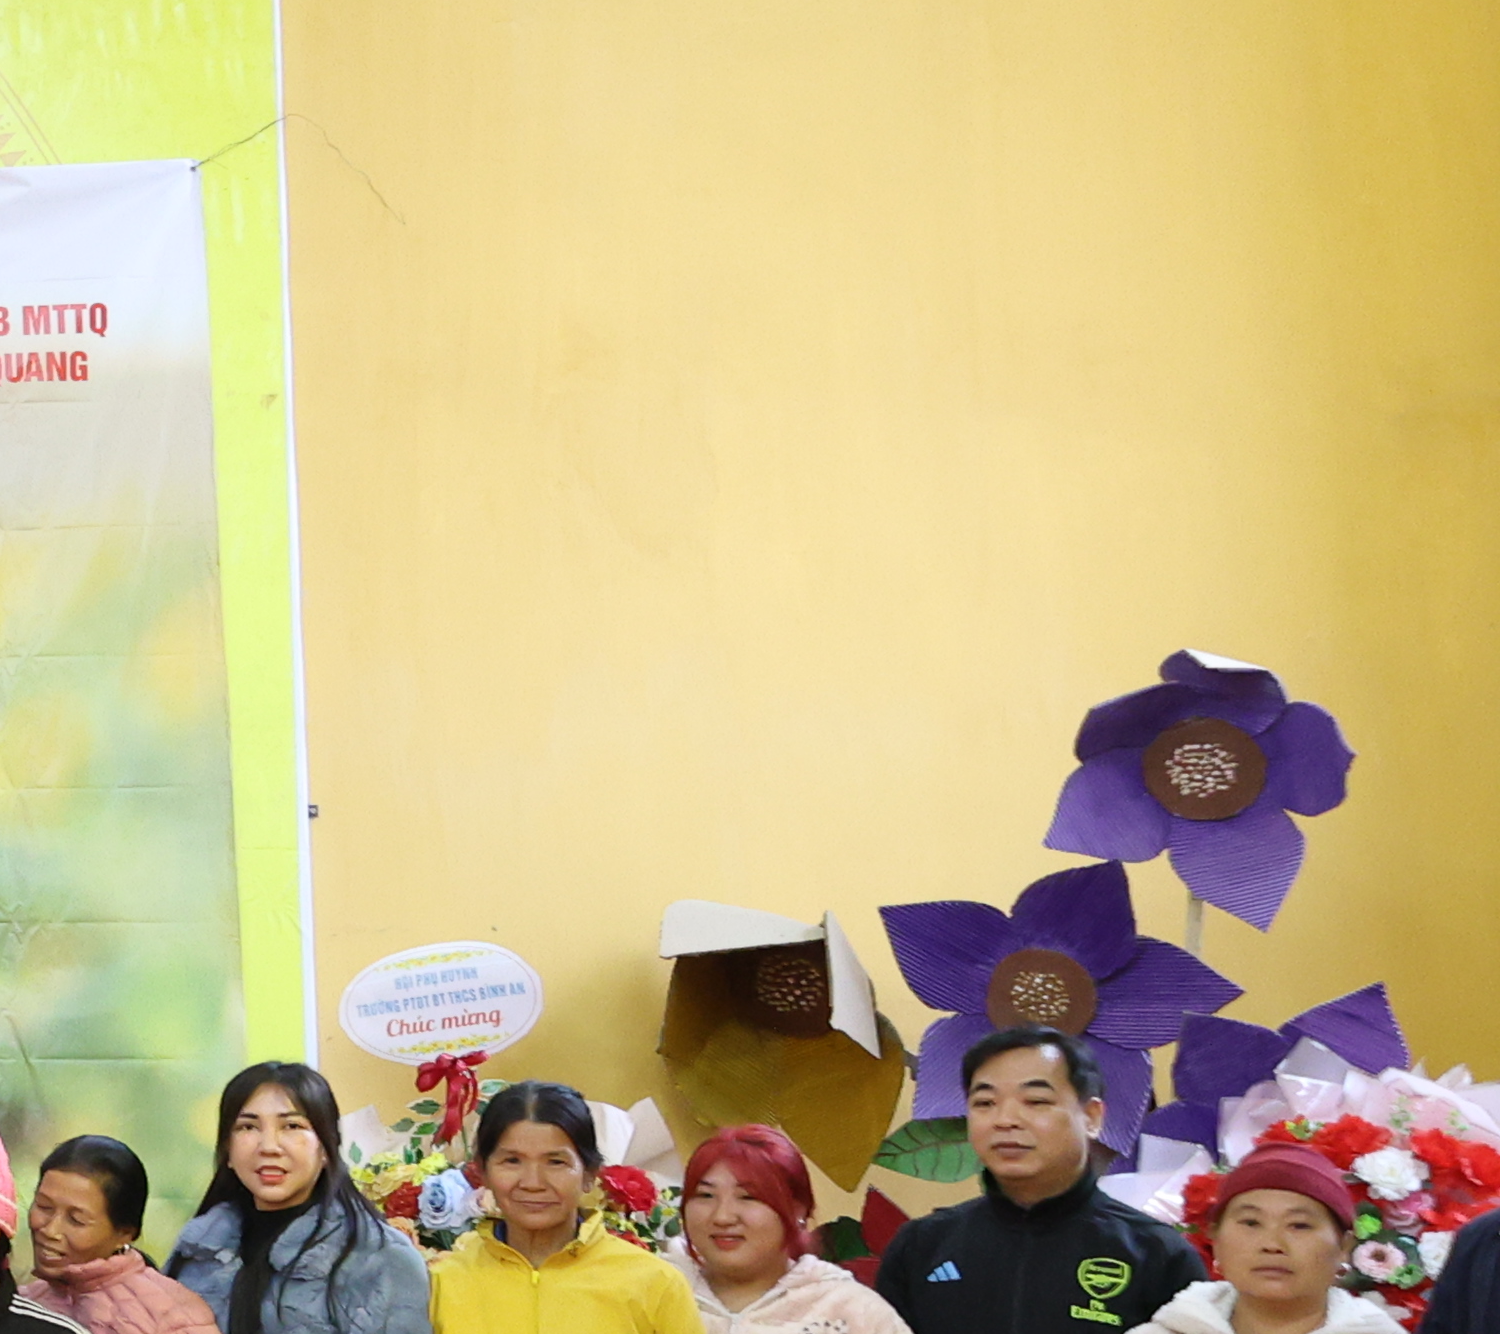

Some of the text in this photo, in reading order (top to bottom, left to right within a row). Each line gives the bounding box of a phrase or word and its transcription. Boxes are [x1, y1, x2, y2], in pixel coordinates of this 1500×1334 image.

[22, 303, 108, 337] MTTQ
[387, 1009, 501, 1037] Chúc mừng
